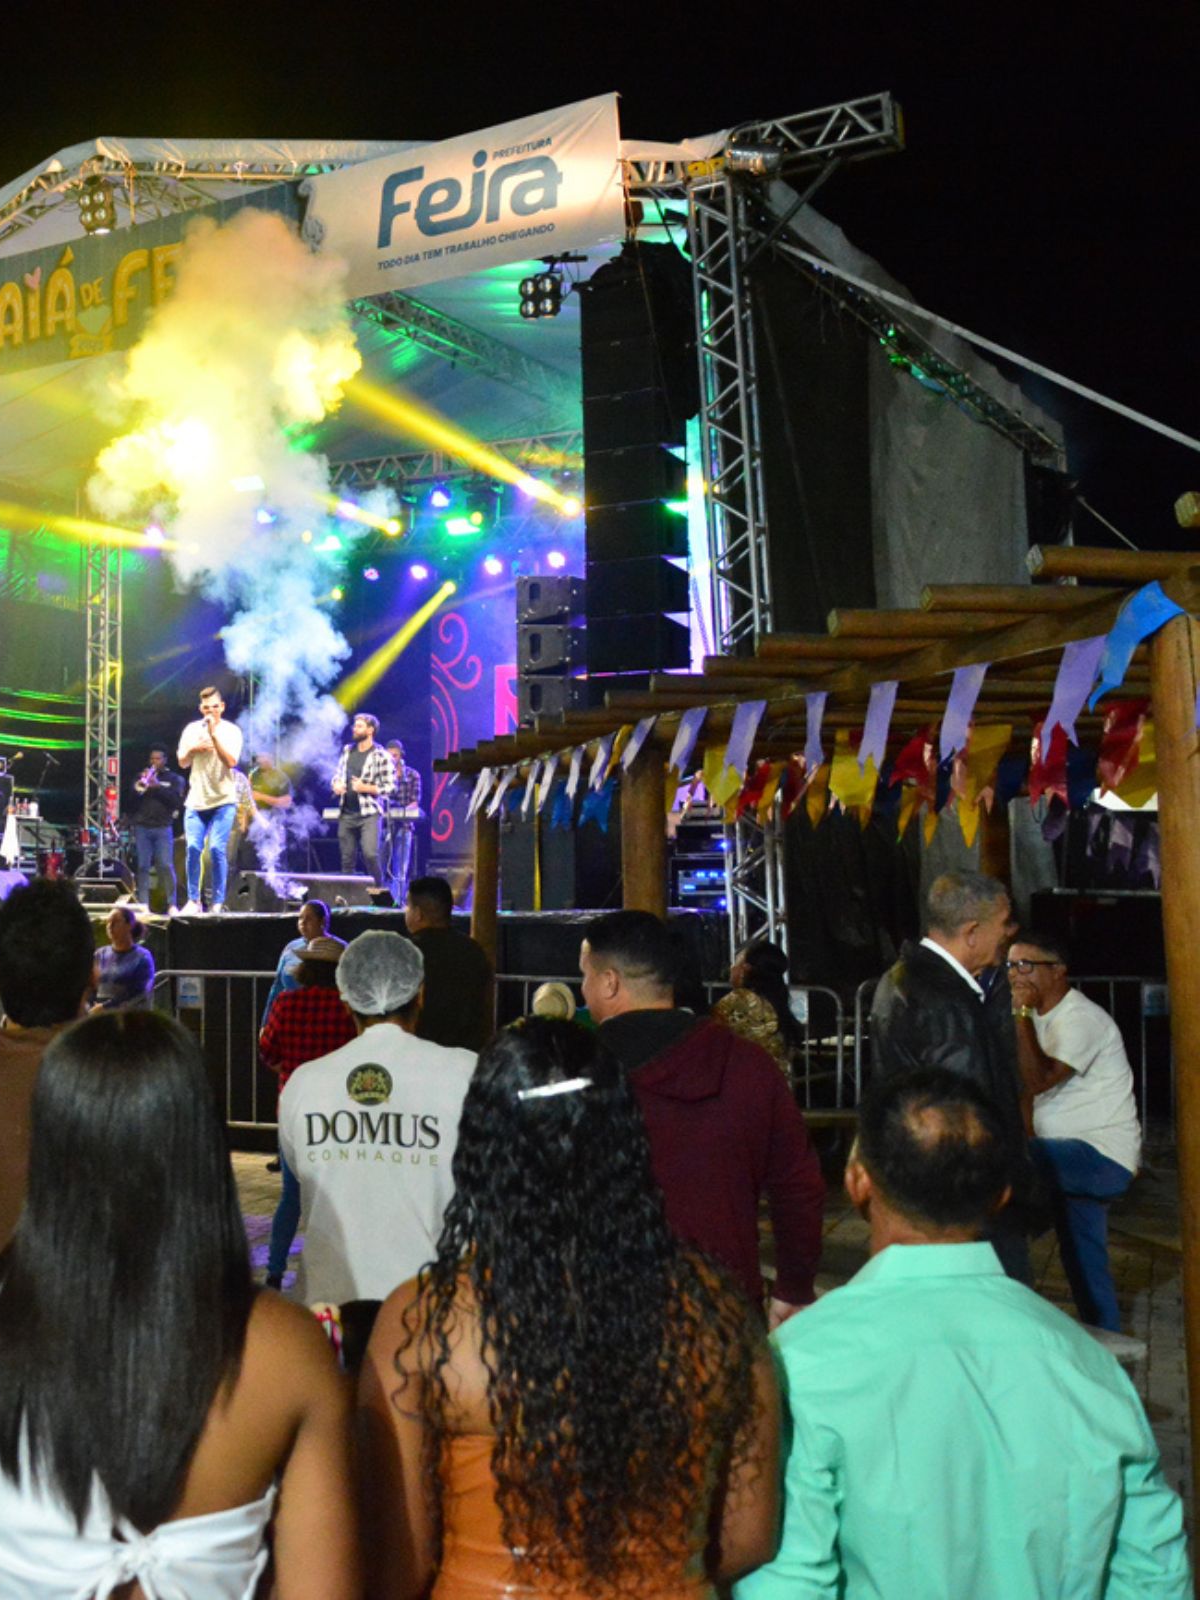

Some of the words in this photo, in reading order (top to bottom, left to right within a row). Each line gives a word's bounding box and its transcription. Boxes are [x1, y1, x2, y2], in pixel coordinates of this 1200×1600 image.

[492, 136, 553, 160] PREFEITURA
[376, 149, 563, 249] Feira
[377, 256, 403, 271] TODO
[404, 252, 421, 265] DIA
[422, 248, 443, 261] TEM
[444, 235, 497, 255] TRABALHO
[498, 222, 556, 243] CHEGANDO
[79, 276, 104, 308] DE
[111, 241, 186, 326] FE
[304, 1109, 441, 1150] DOMUS
[306, 1150, 439, 1167] CONHAQUE
